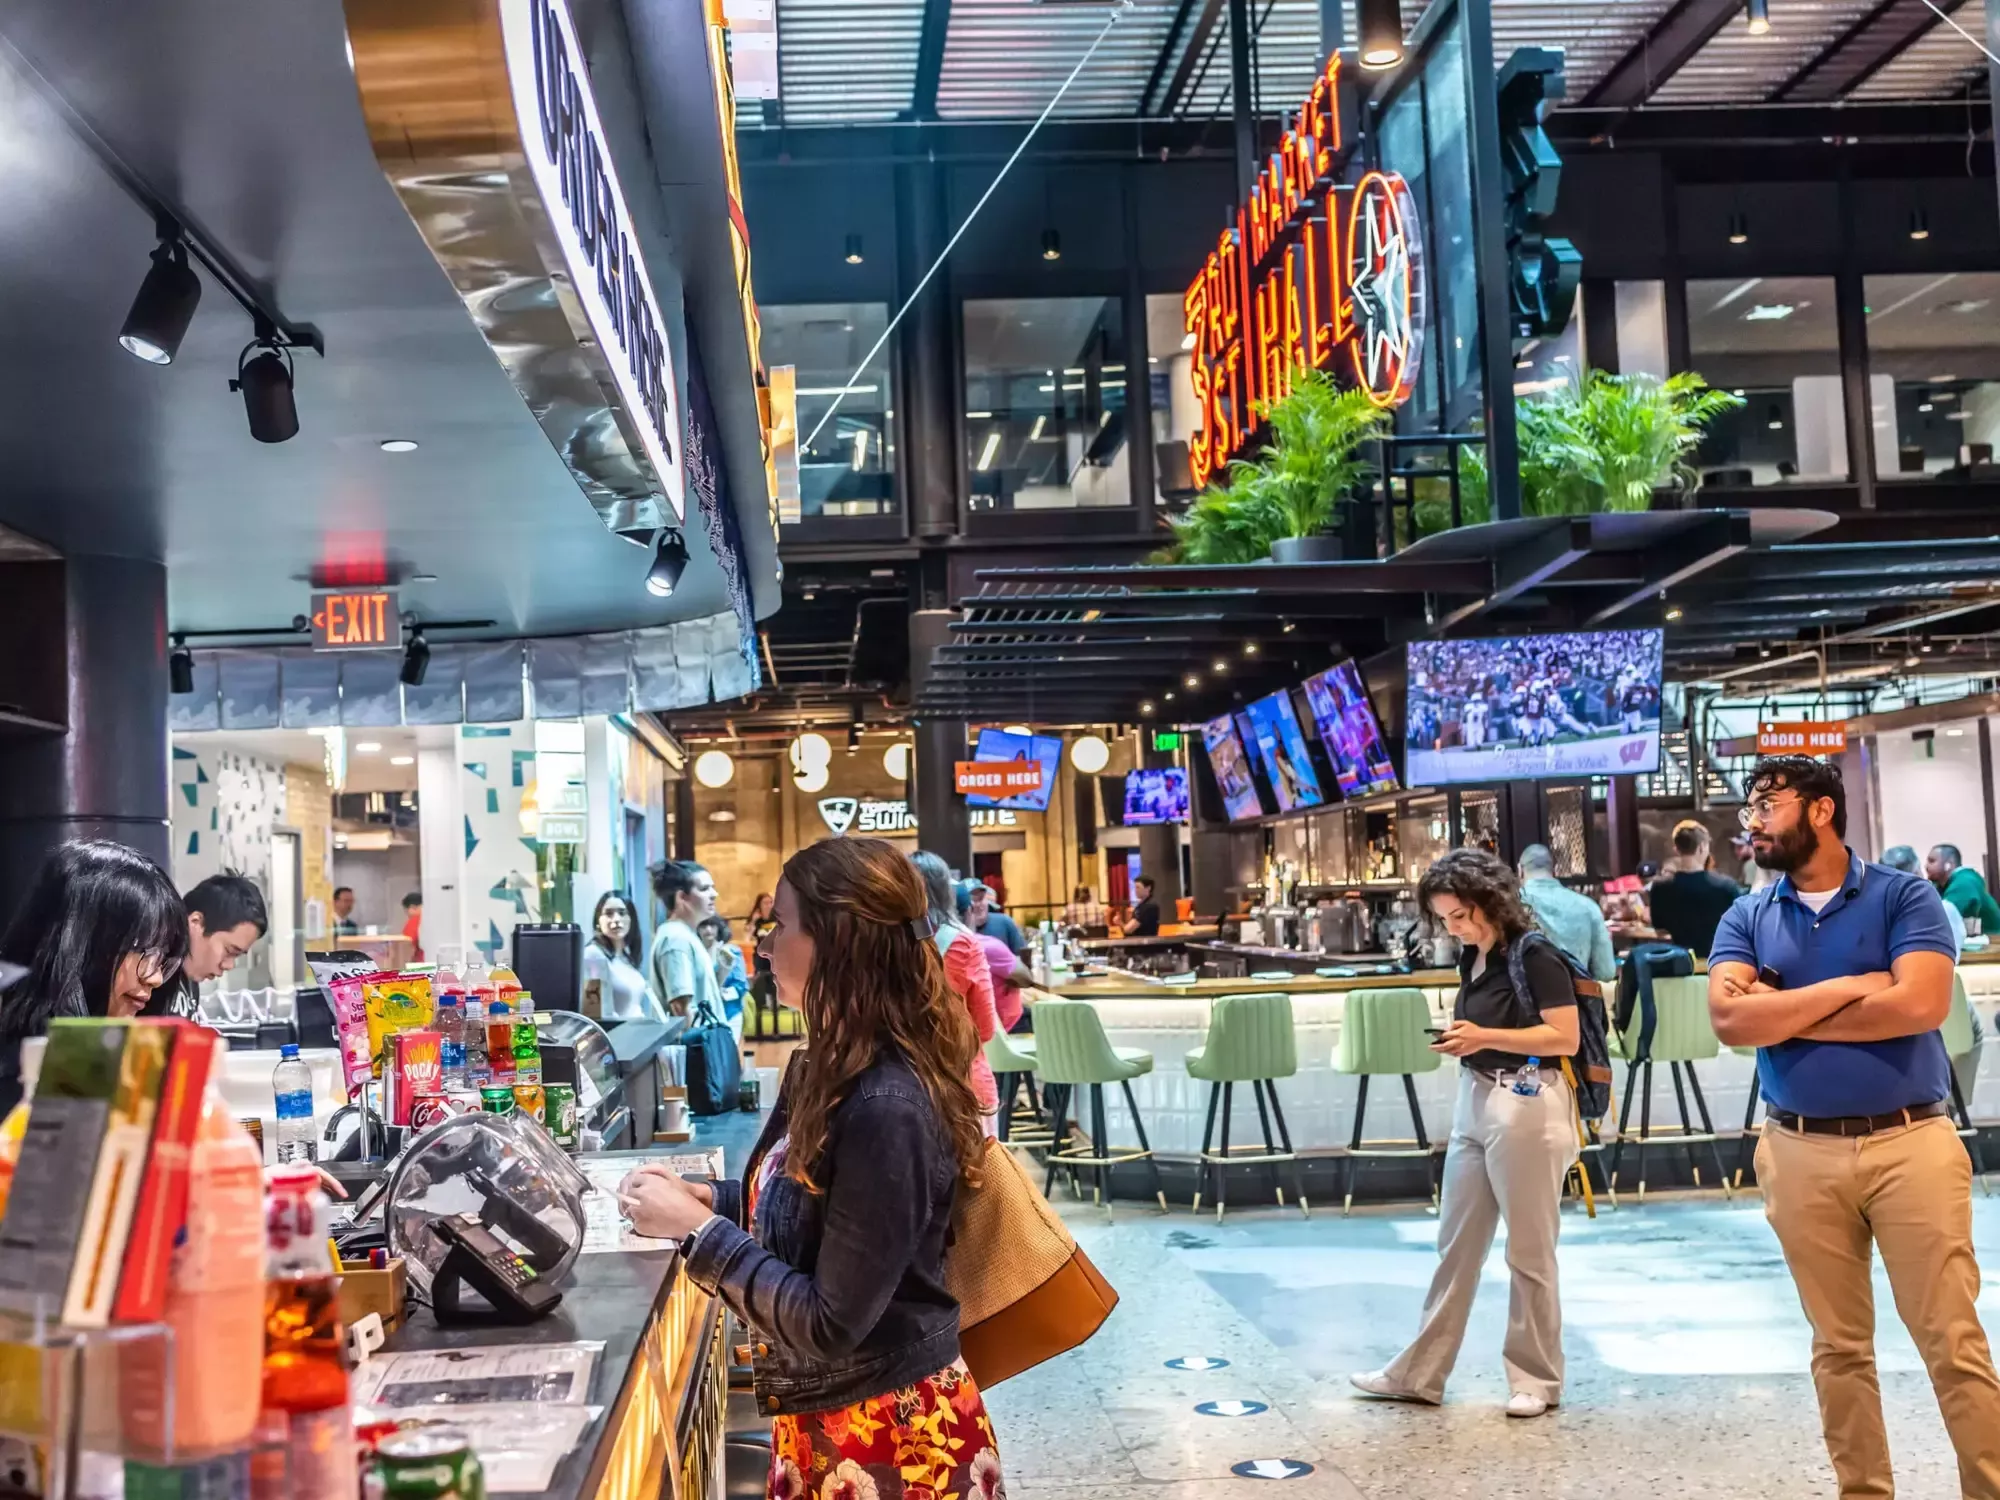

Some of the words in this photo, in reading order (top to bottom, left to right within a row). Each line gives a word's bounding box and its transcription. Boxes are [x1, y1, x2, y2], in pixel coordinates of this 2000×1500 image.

[1257, 183, 1355, 420] HALL
[326, 594, 388, 643] EXIT
[1761, 733, 1804, 746] ORDER
[1810, 732, 1843, 746] HERE
[959, 774, 1001, 787] ORDER
[1007, 772, 1041, 785] HERE
[858, 812, 919, 831] SWIN
